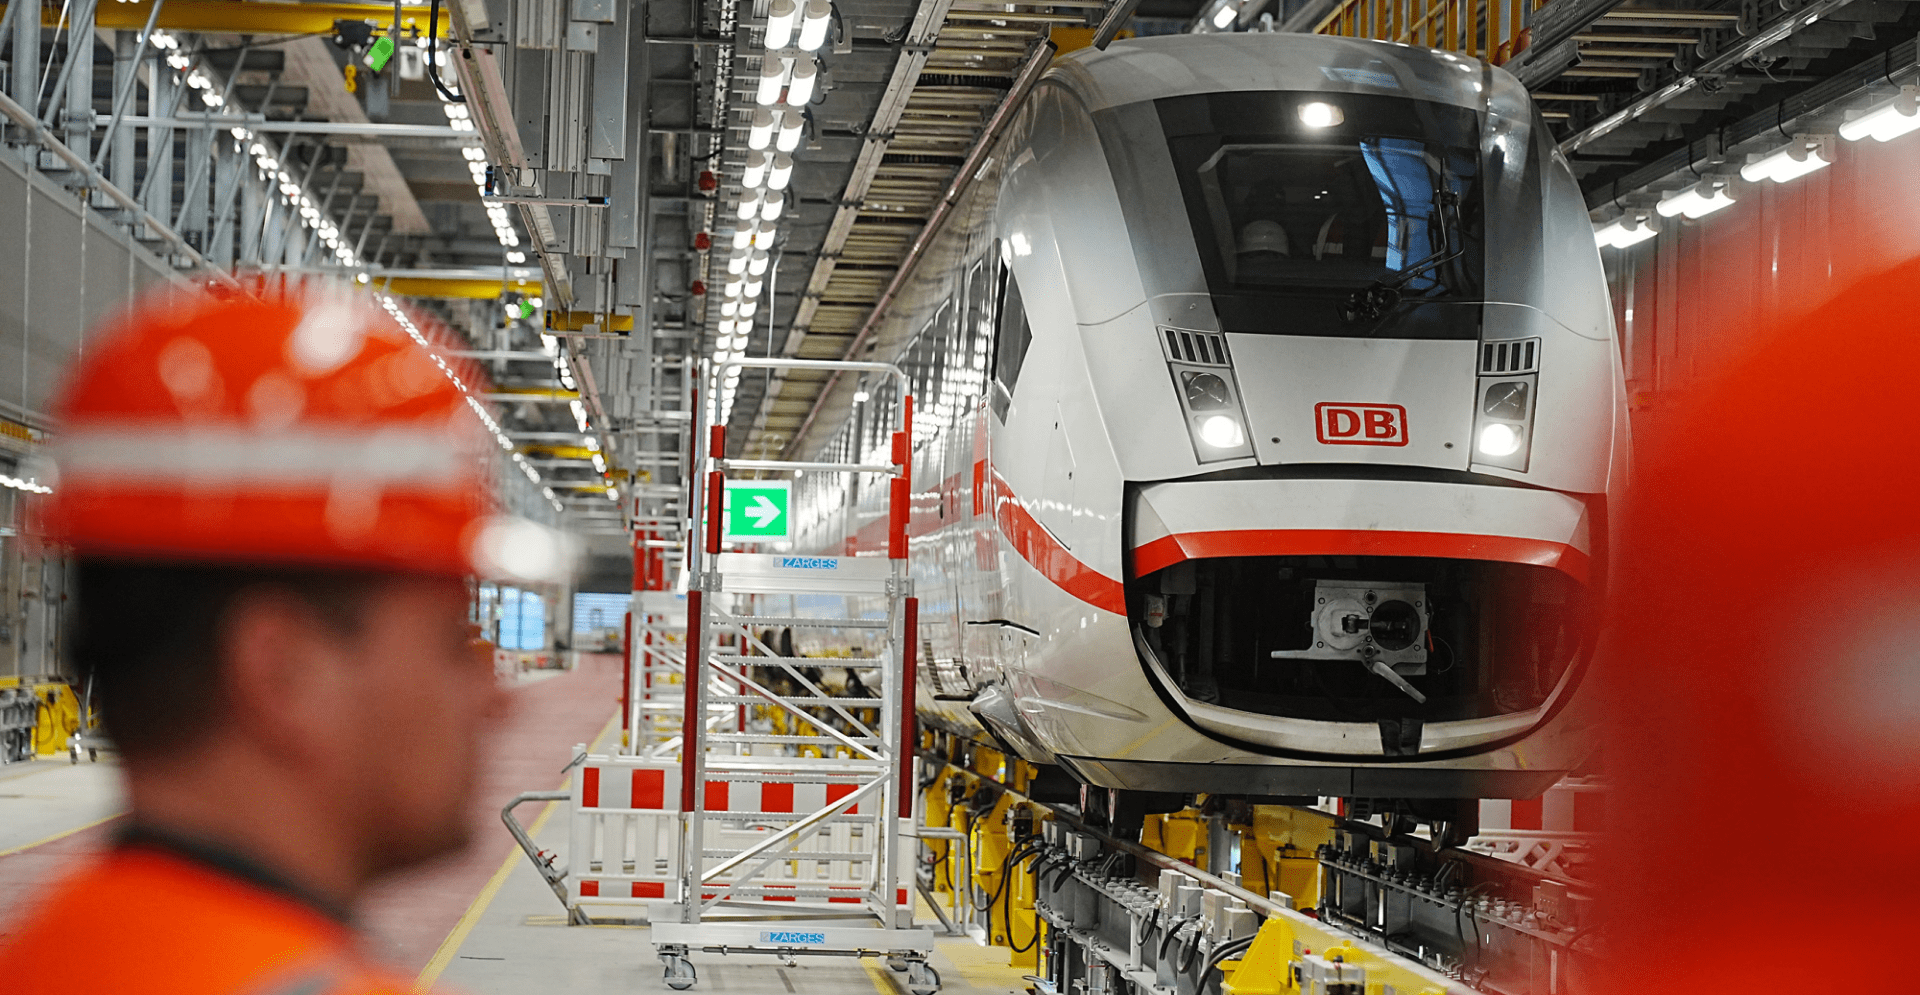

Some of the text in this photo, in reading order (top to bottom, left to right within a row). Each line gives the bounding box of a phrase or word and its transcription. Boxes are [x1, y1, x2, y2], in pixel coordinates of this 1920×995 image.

[1327, 408, 1398, 439] DB
[783, 557, 837, 569] ZARGES
[770, 932, 824, 943] ZARGES
